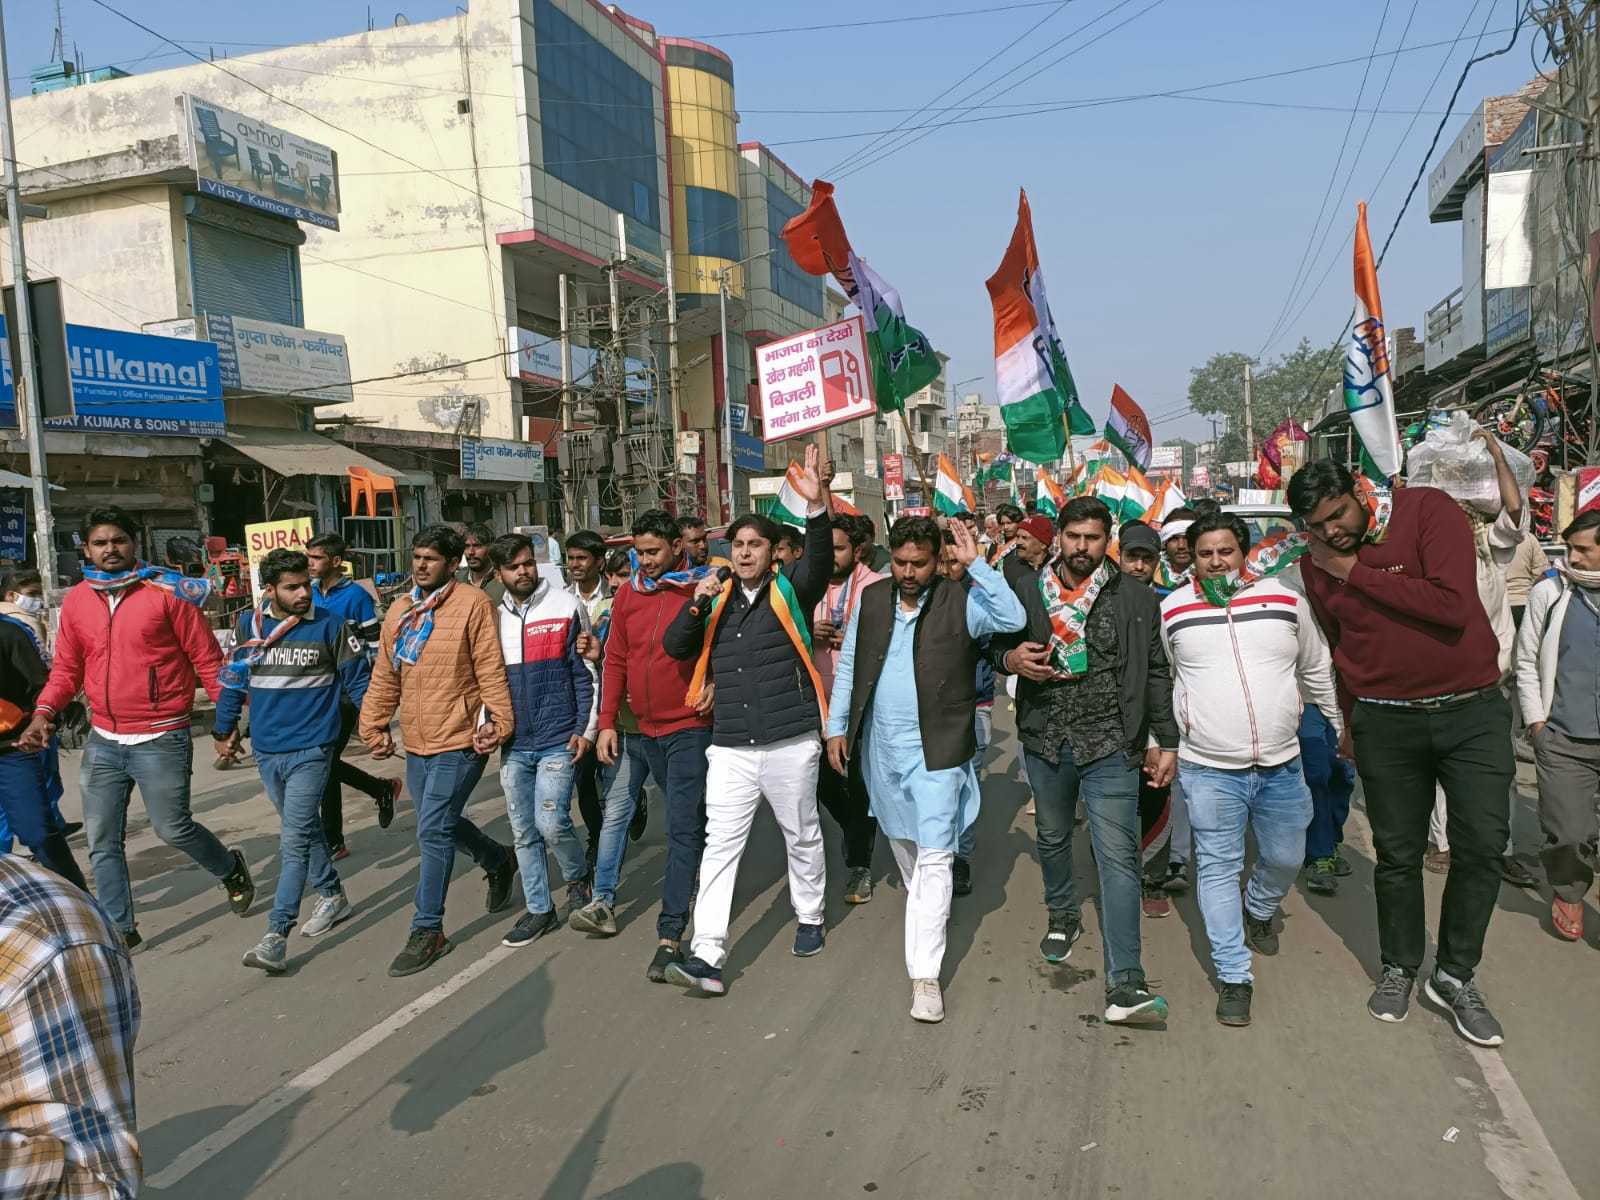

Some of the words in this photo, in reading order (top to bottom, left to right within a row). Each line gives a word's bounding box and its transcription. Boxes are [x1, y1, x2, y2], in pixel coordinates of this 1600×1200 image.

[206, 180, 245, 201] Vijay
[248, 194, 289, 215] Kumar
[294, 207, 304, 218] &
[309, 213, 336, 228] Sons
[237, 329, 268, 349] गुप्ता
[270, 330, 296, 349] फोम
[302, 337, 343, 357] फर्नीचर
[765, 342, 803, 362] भाजपा
[807, 336, 823, 349] का
[826, 324, 853, 343] देखो
[765, 368, 786, 384] खेल
[788, 355, 816, 377] महंगी
[769, 381, 817, 408] बिजली
[84, 416, 131, 430] KUMAR
[134, 418, 142, 430] &
[145, 419, 179, 432] SONS
[770, 411, 800, 428] महंगा
[802, 405, 822, 420] तेल
[251, 526, 312, 551] SURAJ
